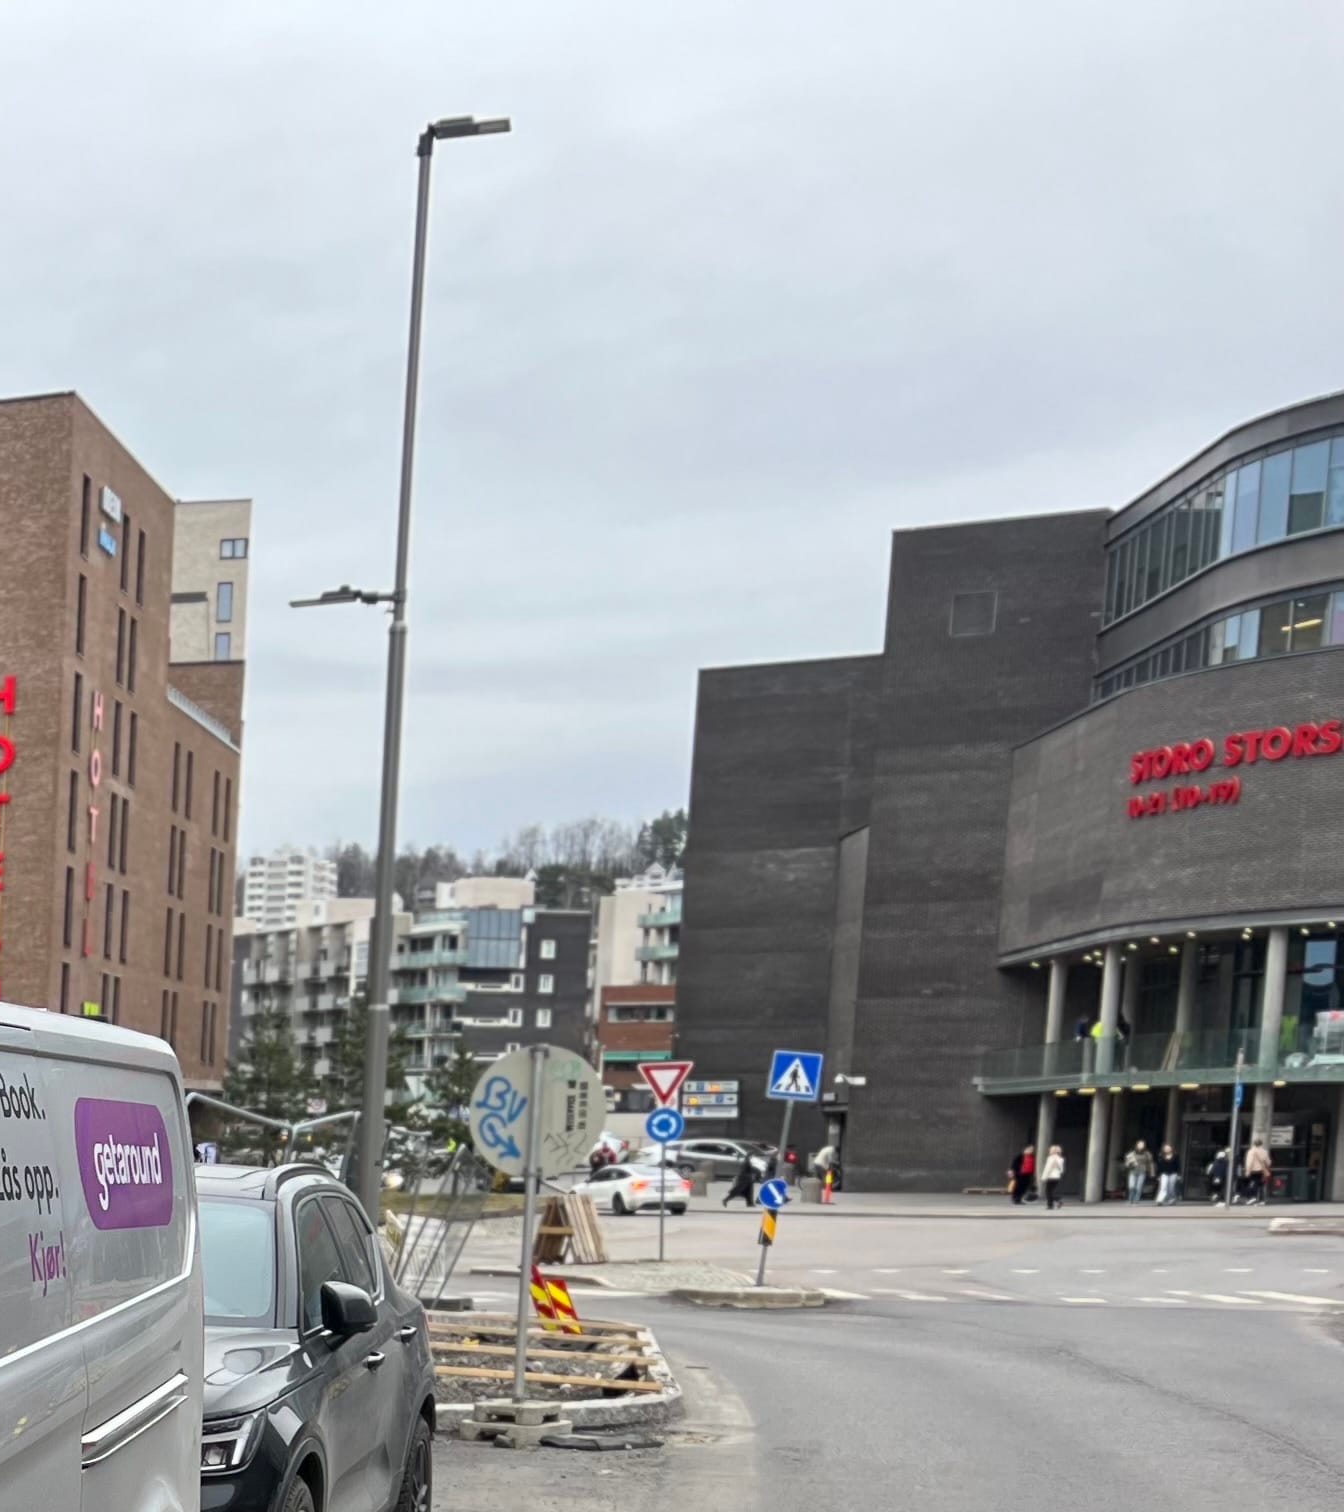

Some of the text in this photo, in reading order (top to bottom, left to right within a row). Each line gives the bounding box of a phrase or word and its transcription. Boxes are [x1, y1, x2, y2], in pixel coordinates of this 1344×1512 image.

[1129, 738, 1214, 784] STORO
[24, 1163, 59, 1215] opp.
[94, 1132, 162, 1211] getaround
[28, 1231, 66, 1297] Kjør!
